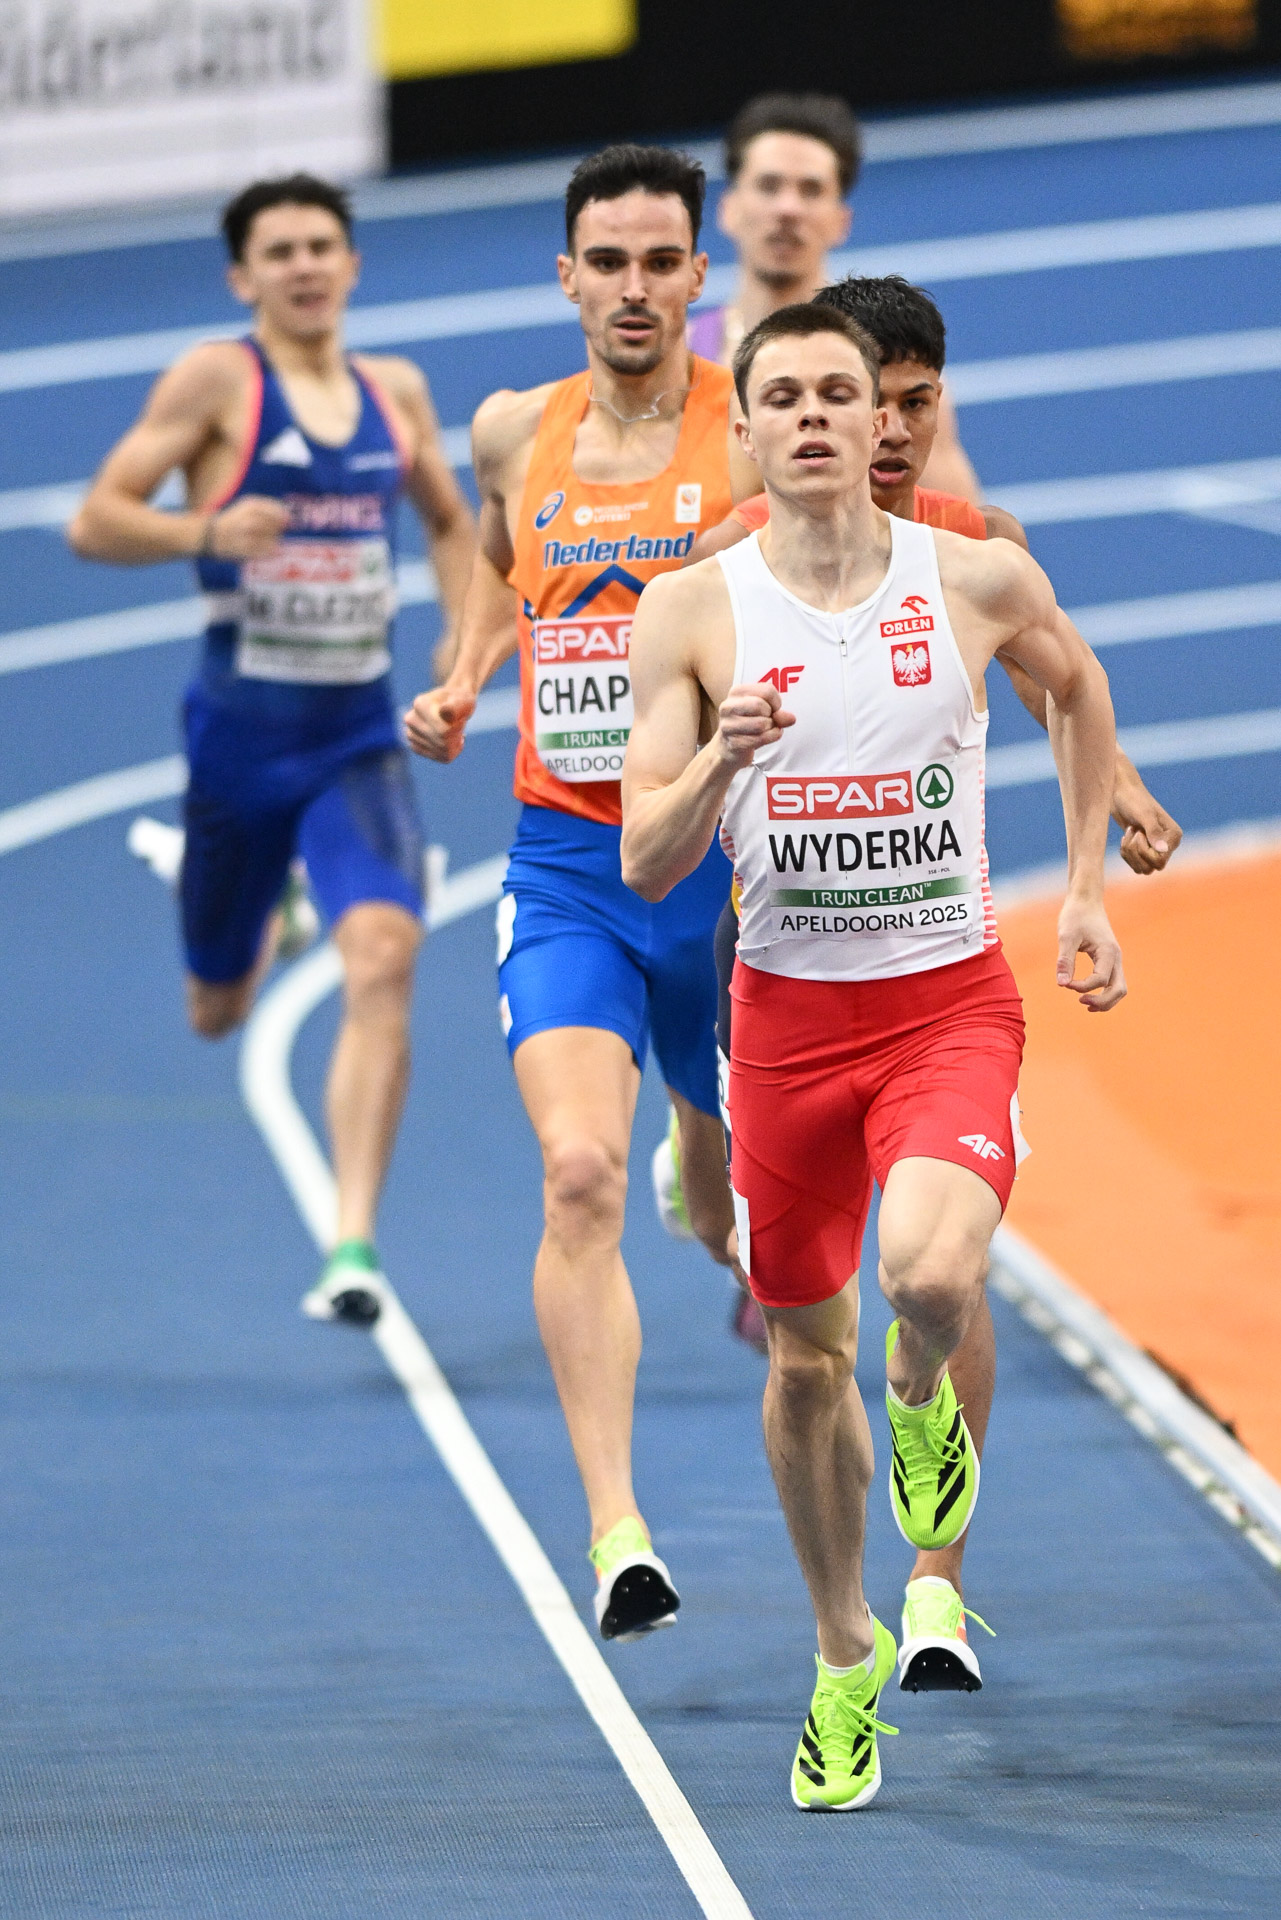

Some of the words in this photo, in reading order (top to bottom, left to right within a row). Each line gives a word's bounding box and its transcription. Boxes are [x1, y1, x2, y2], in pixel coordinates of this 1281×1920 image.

[882, 618, 931, 635] ORLEN
[538, 674, 631, 716] CHAP
[563, 734, 568, 747] I
[570, 732, 604, 747] RUN
[546, 754, 626, 776] APELDOO
[771, 778, 910, 814] SPAR
[768, 819, 962, 873] WYDERKA
[812, 892, 817, 905] I
[820, 890, 861, 906] RUN
[780, 912, 914, 933] APELDOORN
[919, 903, 968, 926] 2025
